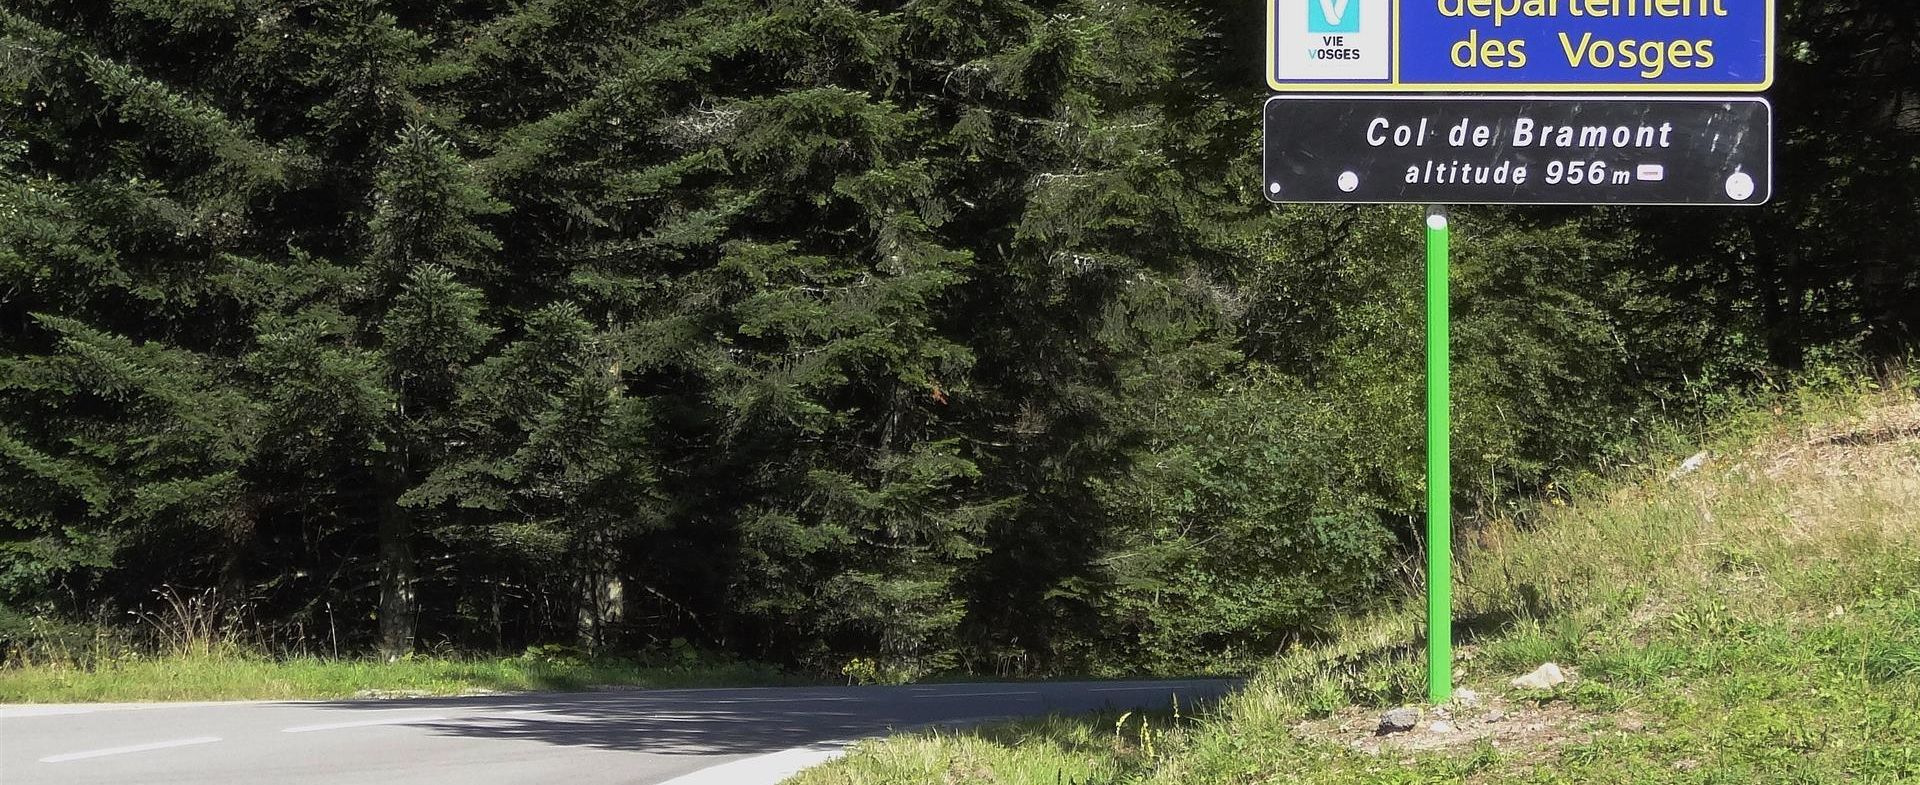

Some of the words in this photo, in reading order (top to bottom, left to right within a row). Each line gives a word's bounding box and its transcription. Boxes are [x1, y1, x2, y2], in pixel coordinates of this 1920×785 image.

[1323, 36, 1344, 46] VIE
[1308, 49, 1360, 60] VOSGES
[1450, 29, 1527, 68] des
[1558, 32, 1714, 79] Vosges
[1366, 118, 1427, 147] Col
[1448, 118, 1490, 147] de
[1512, 118, 1672, 148] Bramont
[1405, 160, 1527, 185] altitude
[1545, 161, 1606, 185] 956
[1612, 170, 1630, 185] m
